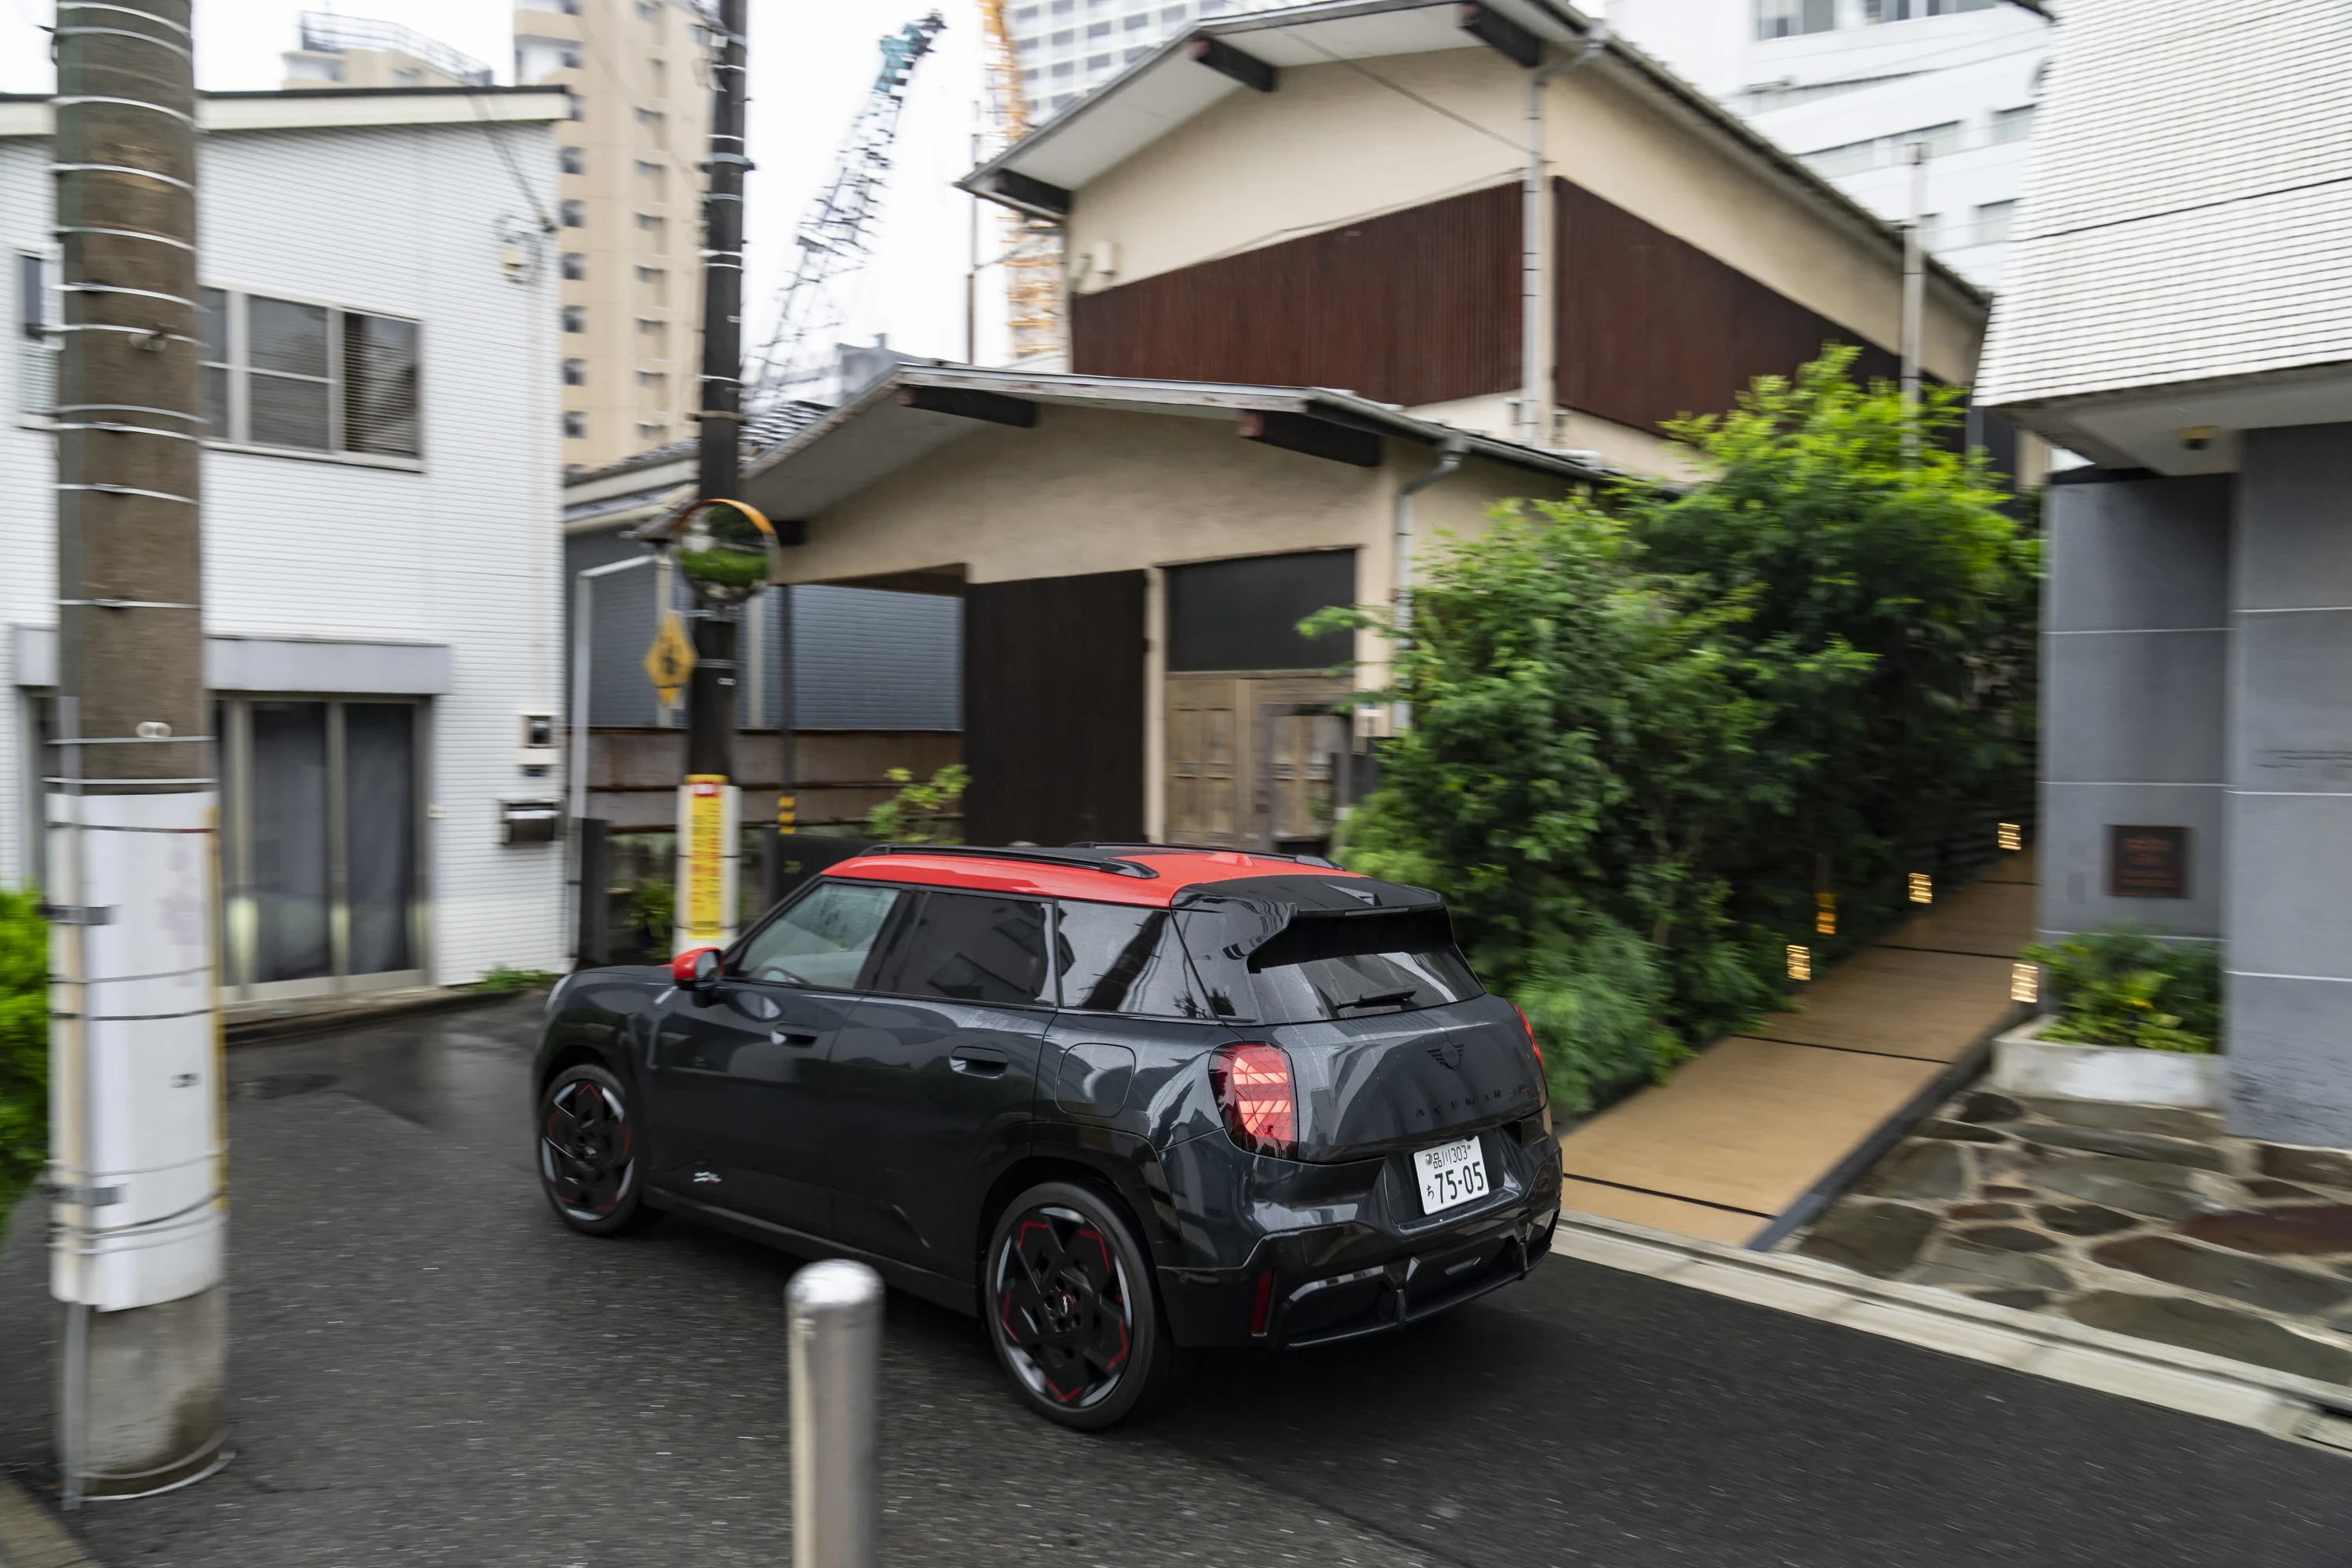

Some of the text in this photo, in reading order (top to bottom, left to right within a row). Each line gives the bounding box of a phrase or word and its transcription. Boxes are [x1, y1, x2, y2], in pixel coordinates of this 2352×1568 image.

[1415, 1089, 1502, 1118] ACEMAN
[1426, 1161, 1484, 1204] ち 75-05
